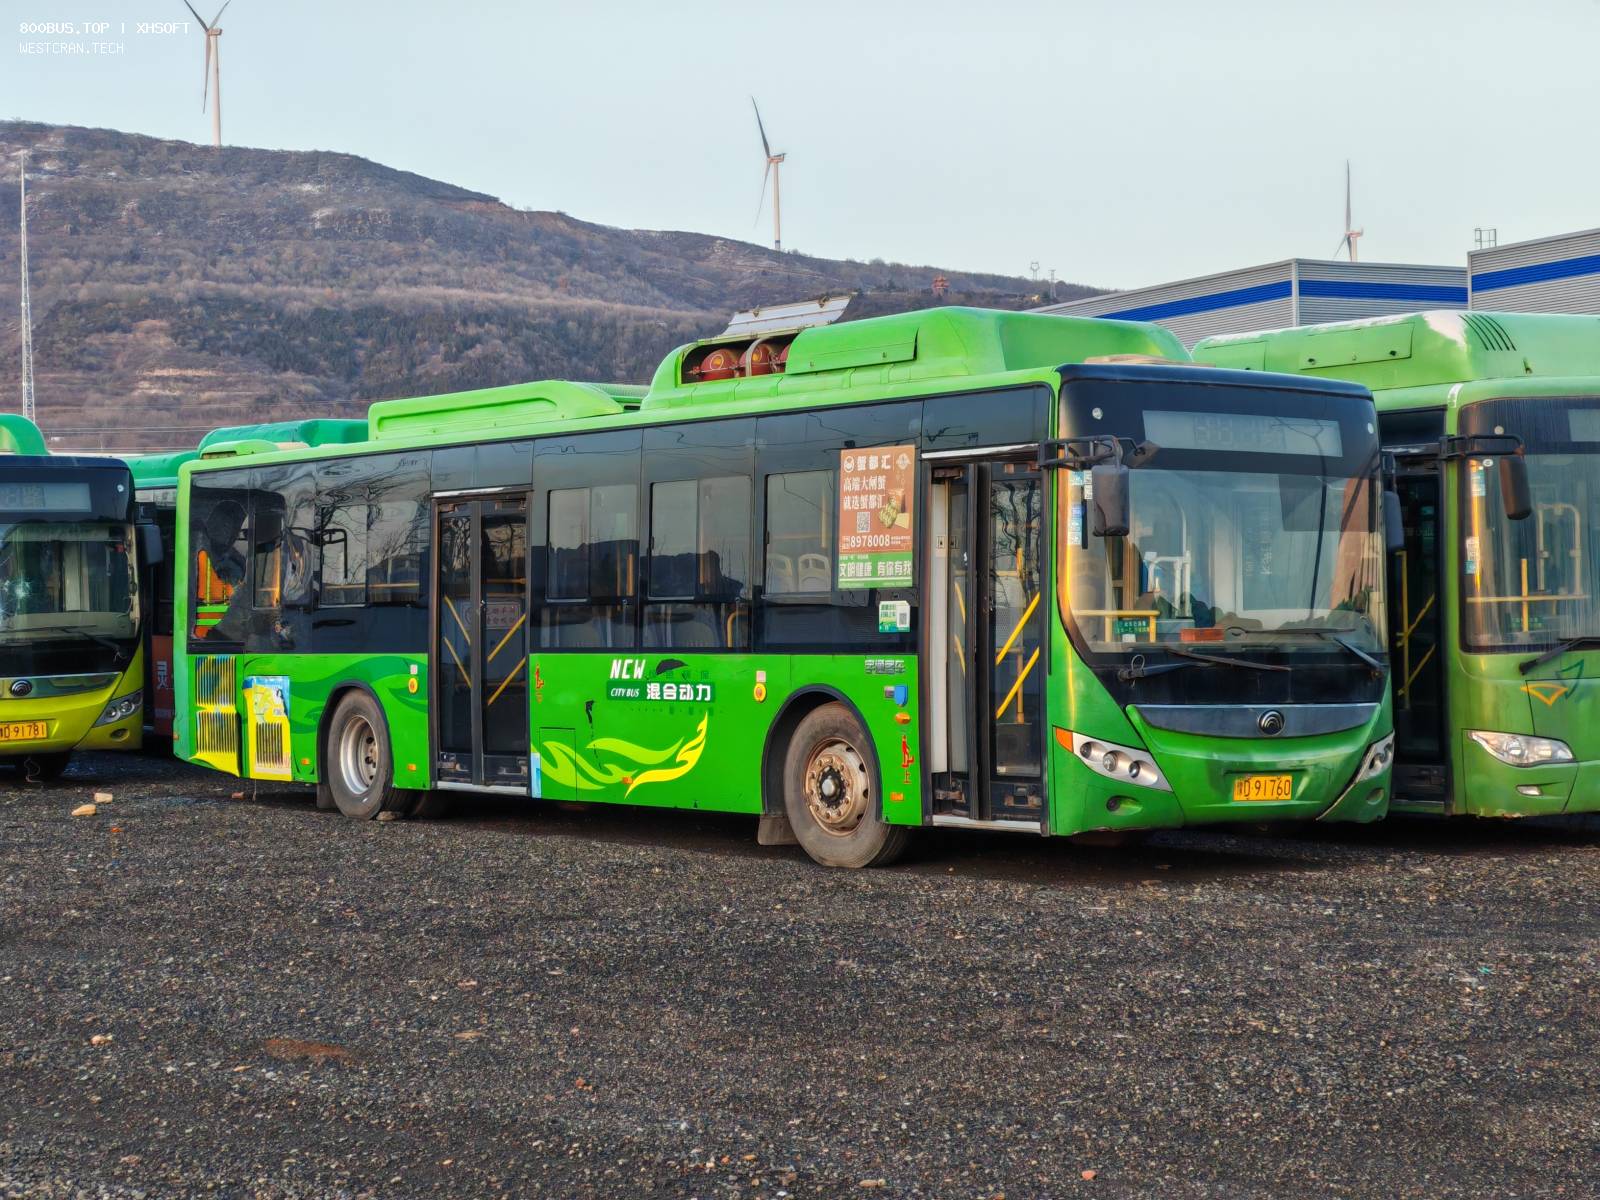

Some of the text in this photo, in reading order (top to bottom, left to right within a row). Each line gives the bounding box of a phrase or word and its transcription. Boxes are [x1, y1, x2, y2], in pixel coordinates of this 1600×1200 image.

[850, 534, 891, 548] 8978008
[610, 688, 640, 698] CITY BUS
[646, 683, 711, 701] 混合动力
